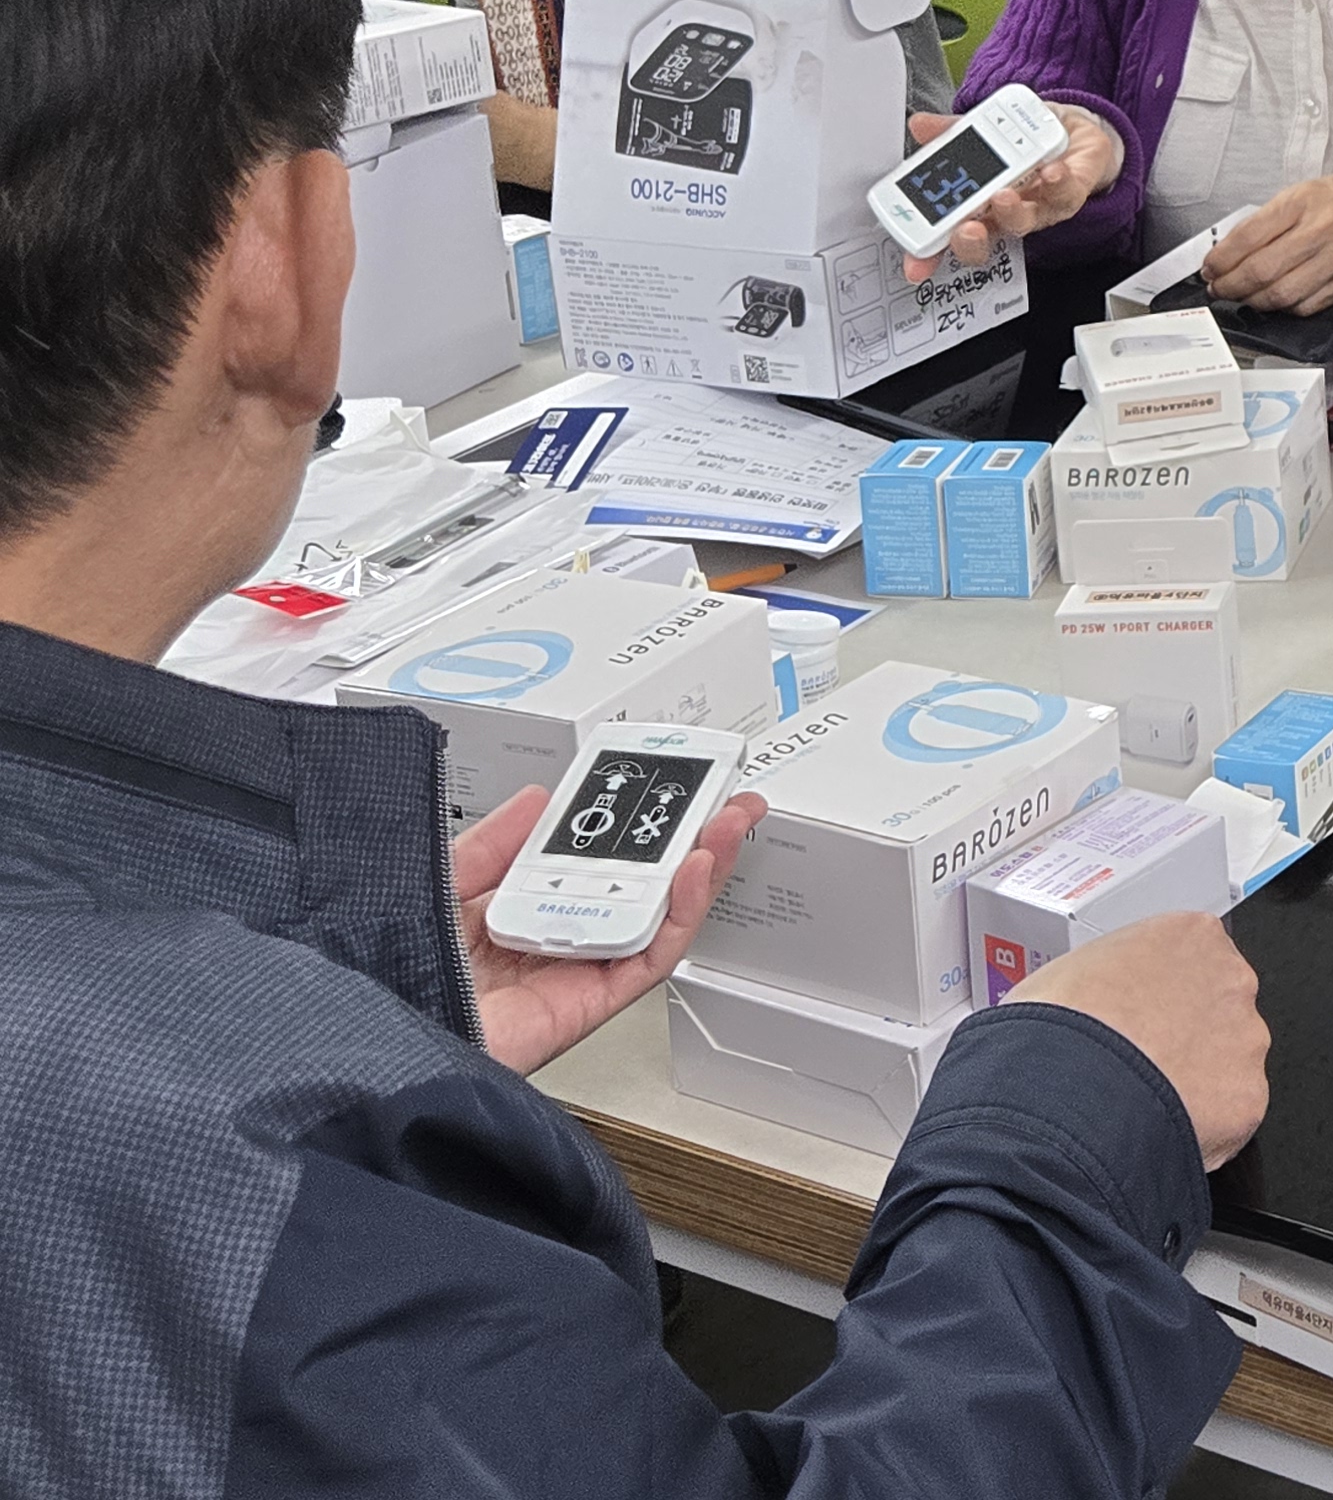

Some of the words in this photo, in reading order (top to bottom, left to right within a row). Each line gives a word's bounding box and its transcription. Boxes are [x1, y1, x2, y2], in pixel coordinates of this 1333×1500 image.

[631, 178, 728, 206] SHB-2100
[685, 208, 726, 218] ACCUNIQ
[1061, 624, 1077, 634] PD
[1081, 623, 1105, 634] 25W
[1113, 622, 1150, 633] 1PORT
[1157, 621, 1214, 632] CHARGER
[996, 947, 1016, 969] B
[1262, 1291, 1333, 1334] 덕유마을4단지
